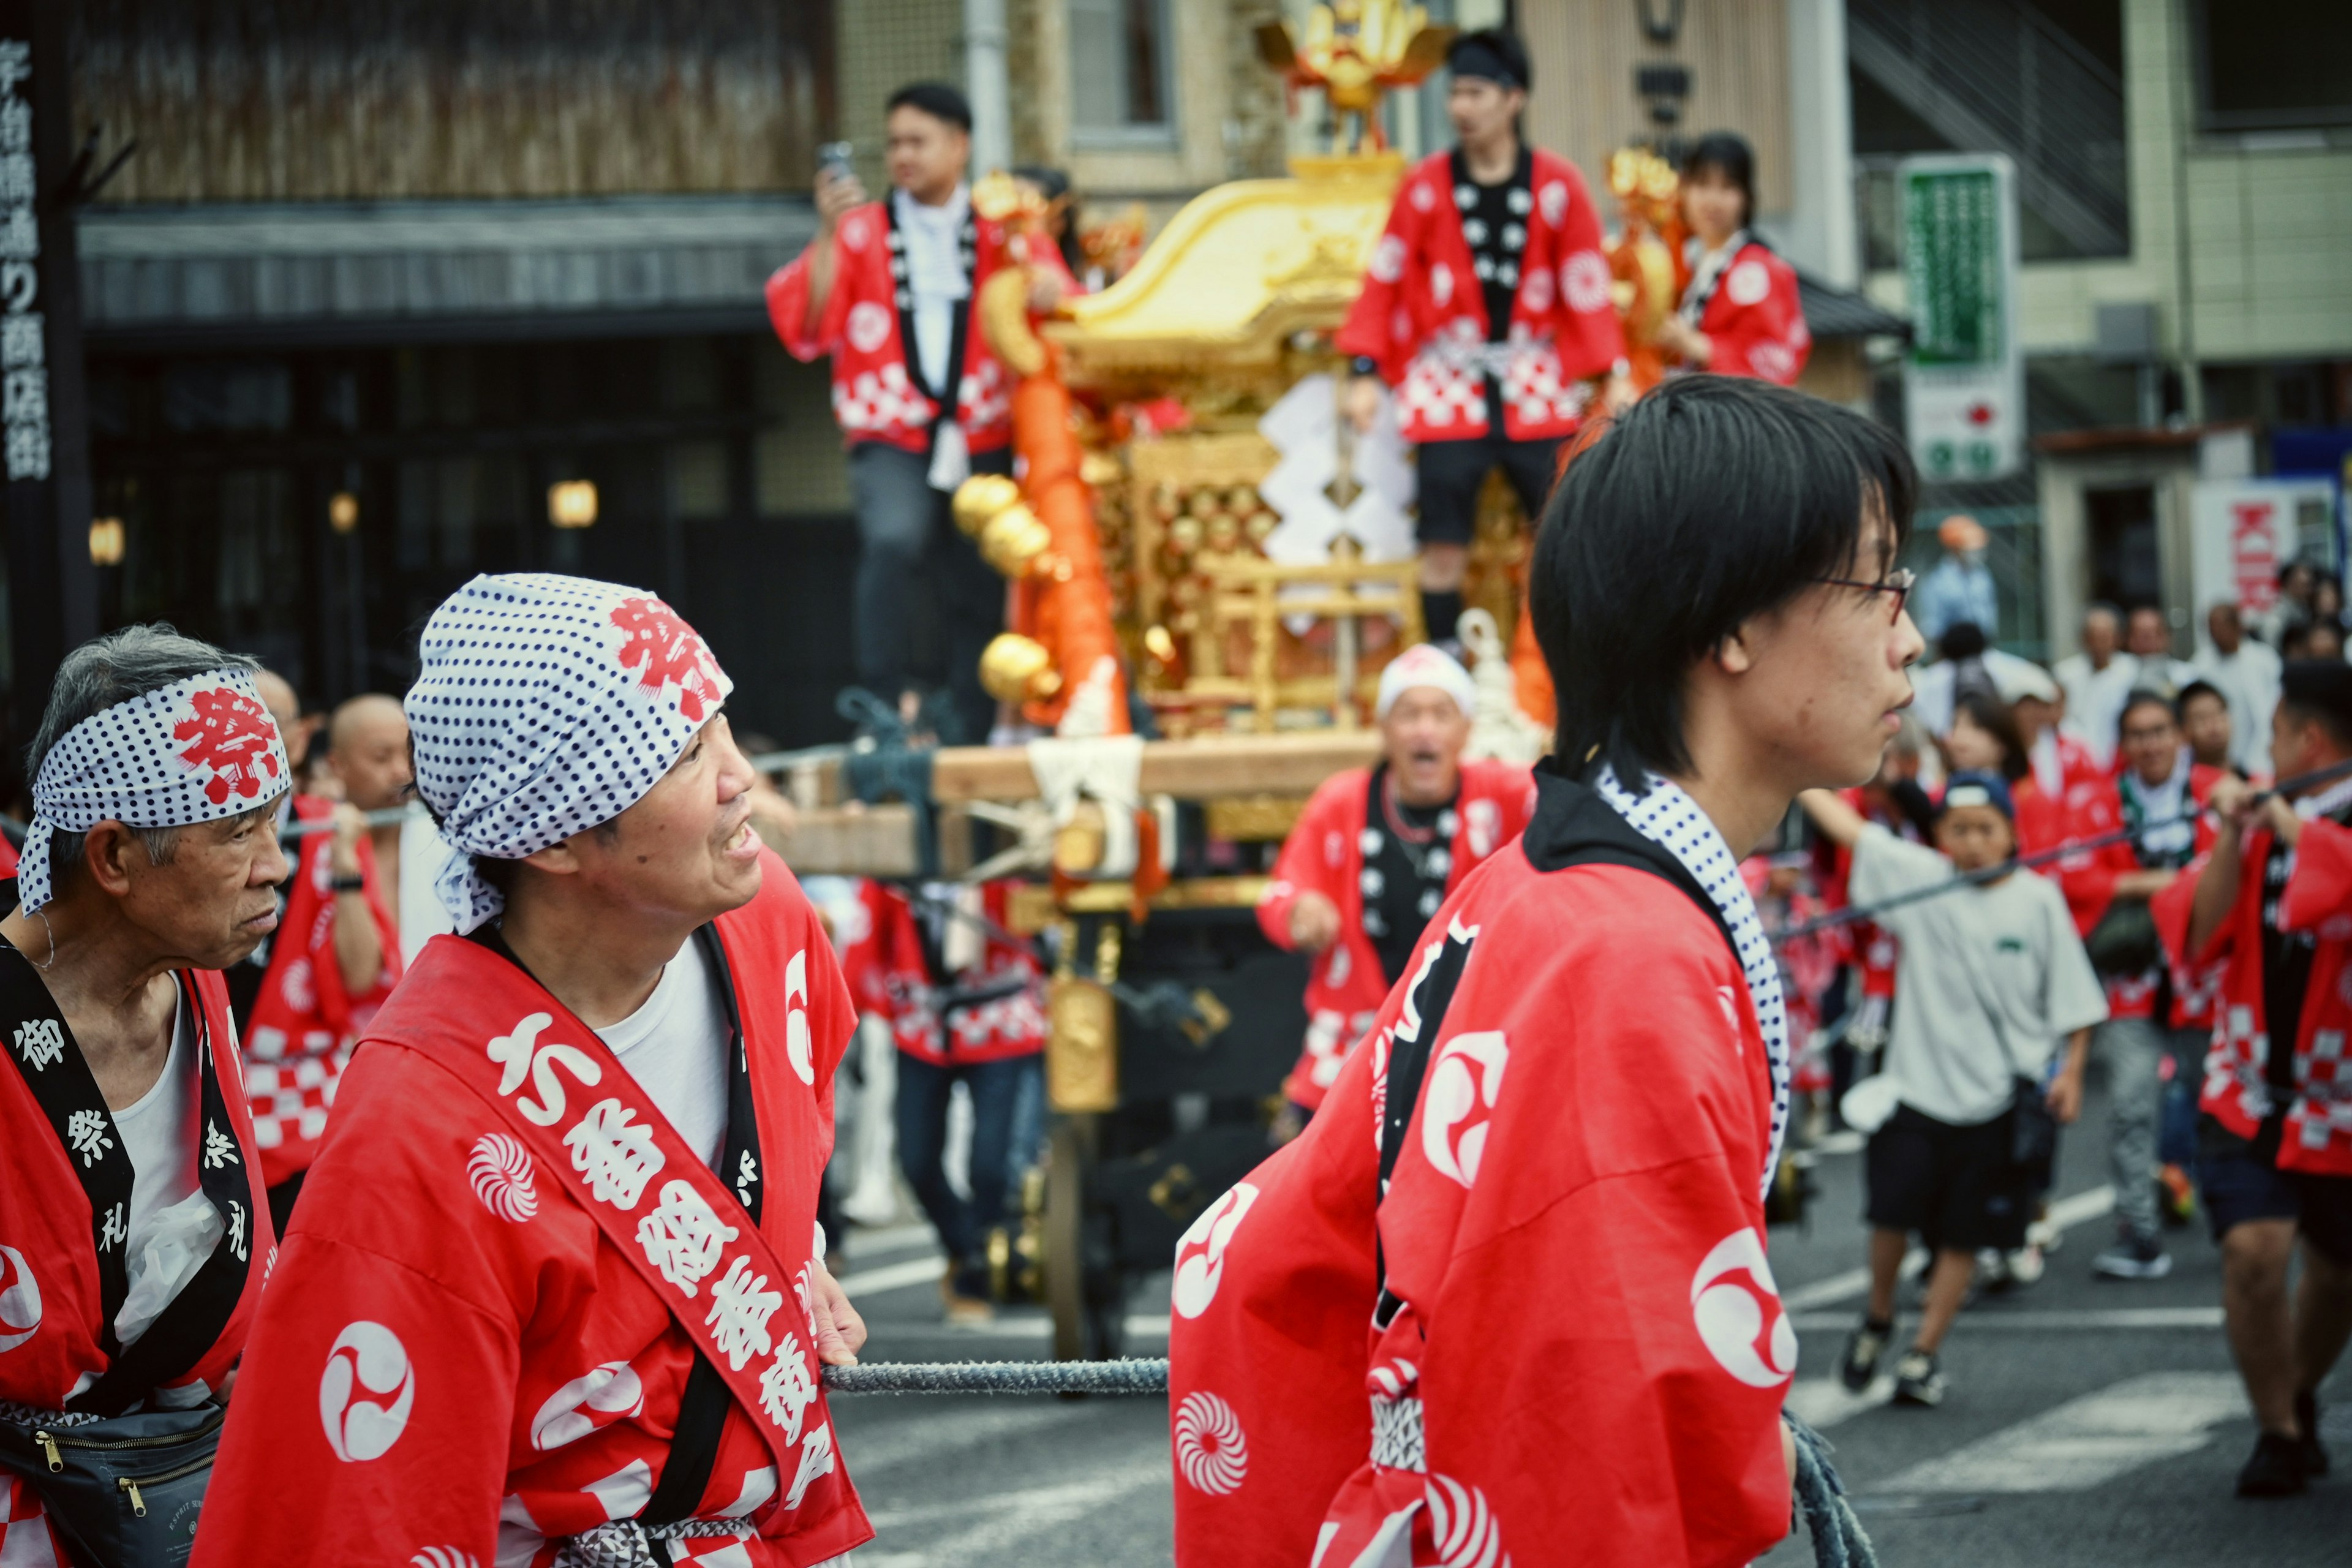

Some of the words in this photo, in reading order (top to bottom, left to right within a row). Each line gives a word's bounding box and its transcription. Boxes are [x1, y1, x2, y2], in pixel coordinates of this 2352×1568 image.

[13, 1018, 127, 1253] 御祭礼
[205, 1020, 247, 1262] 祭礼
[169, 1502, 189, 1531] ESPRIT
